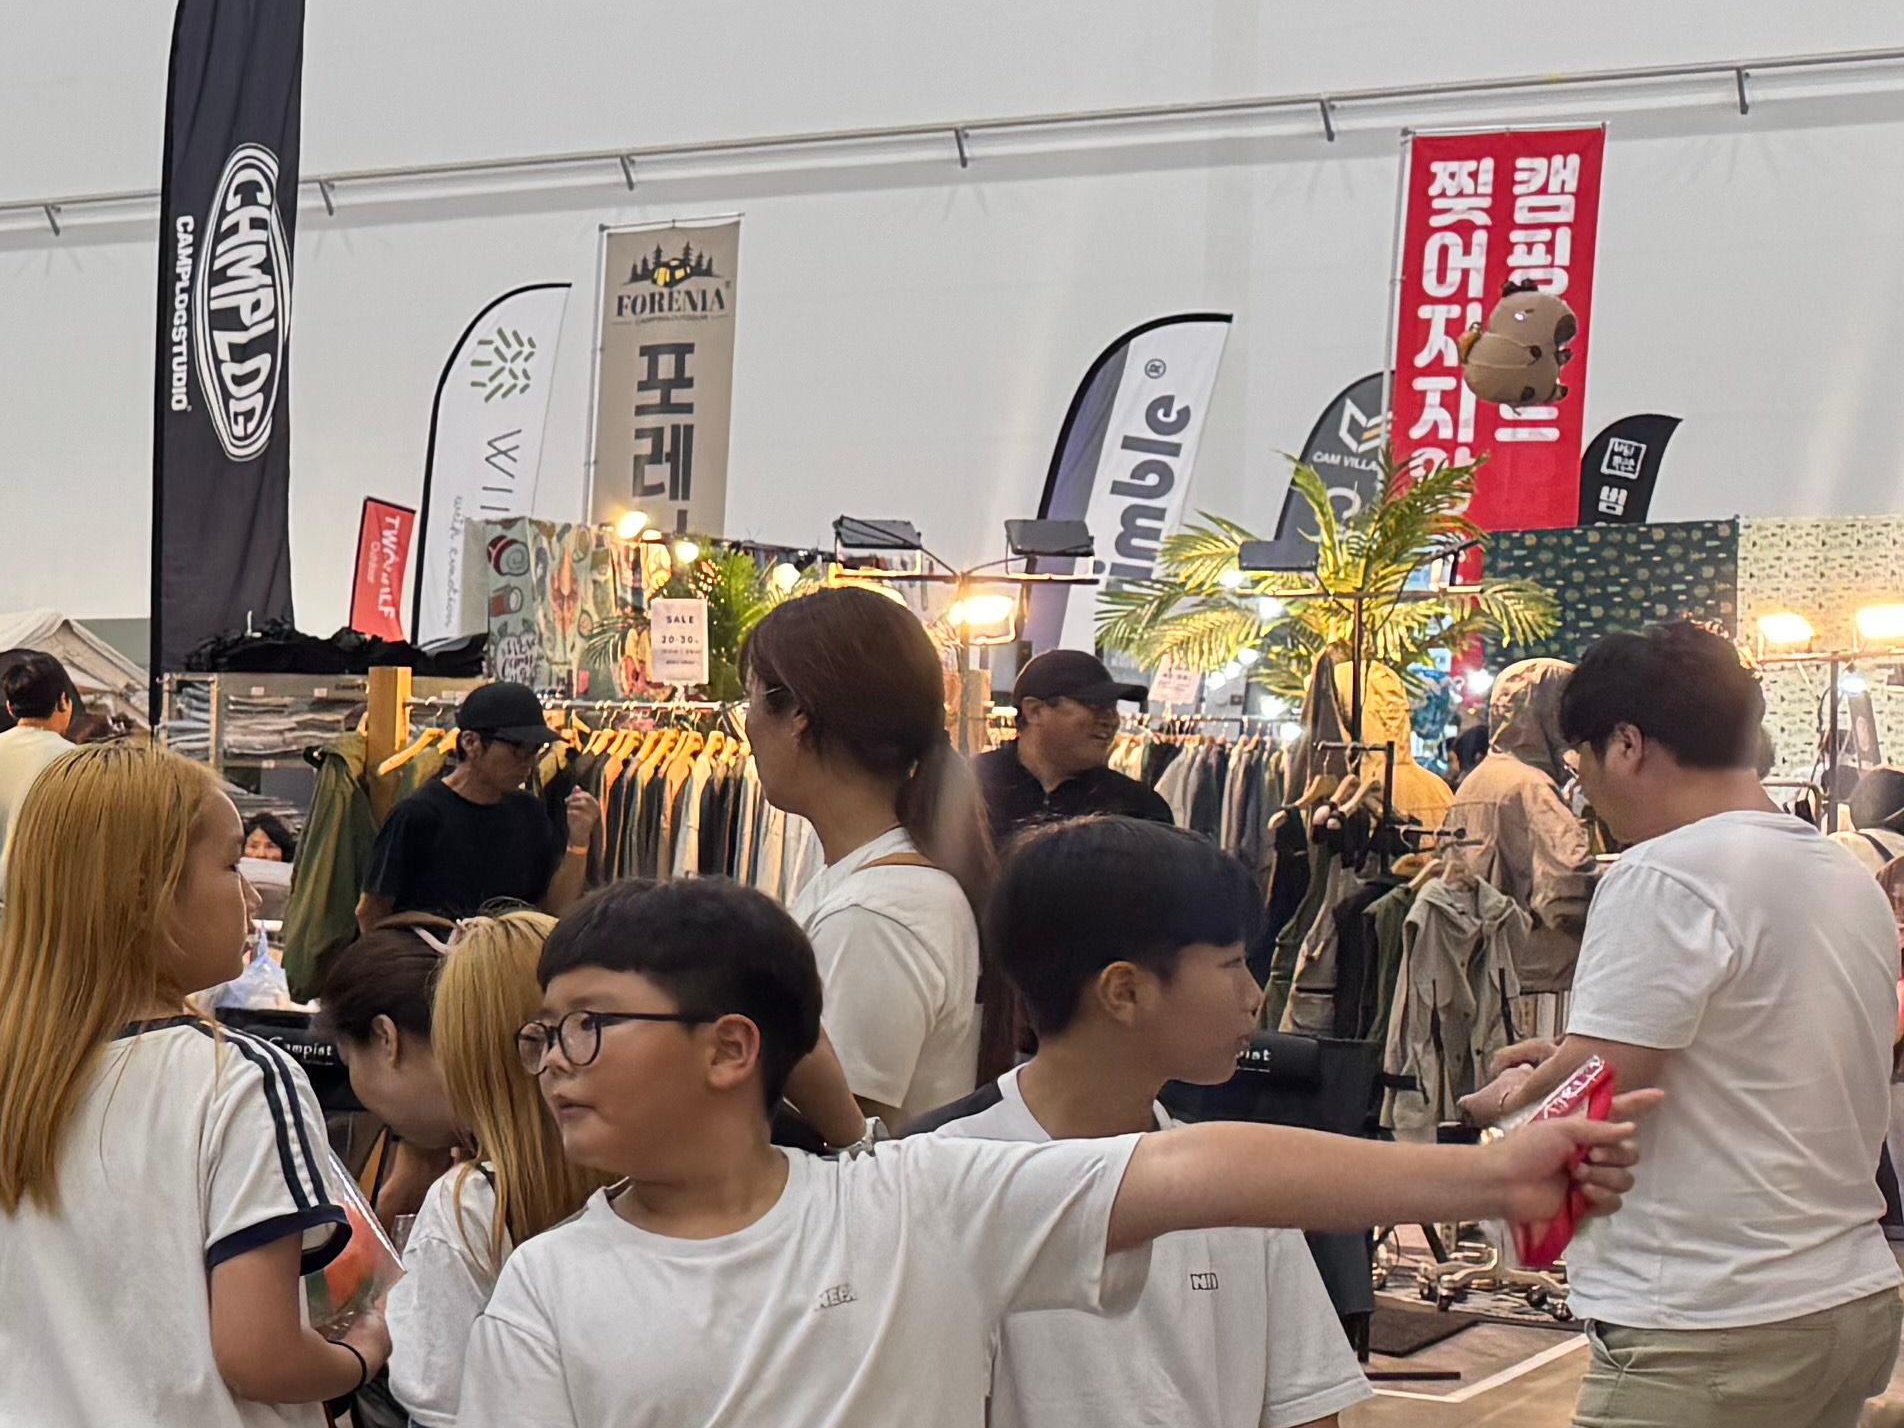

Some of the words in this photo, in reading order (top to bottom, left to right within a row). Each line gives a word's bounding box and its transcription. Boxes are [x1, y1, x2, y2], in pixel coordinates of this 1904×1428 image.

[171, 214, 195, 412] CAMPLOGSTUDIO
[616, 287, 726, 318] FORENIA
[1313, 450, 1342, 466] CAM
[666, 615, 695, 625] SALE
